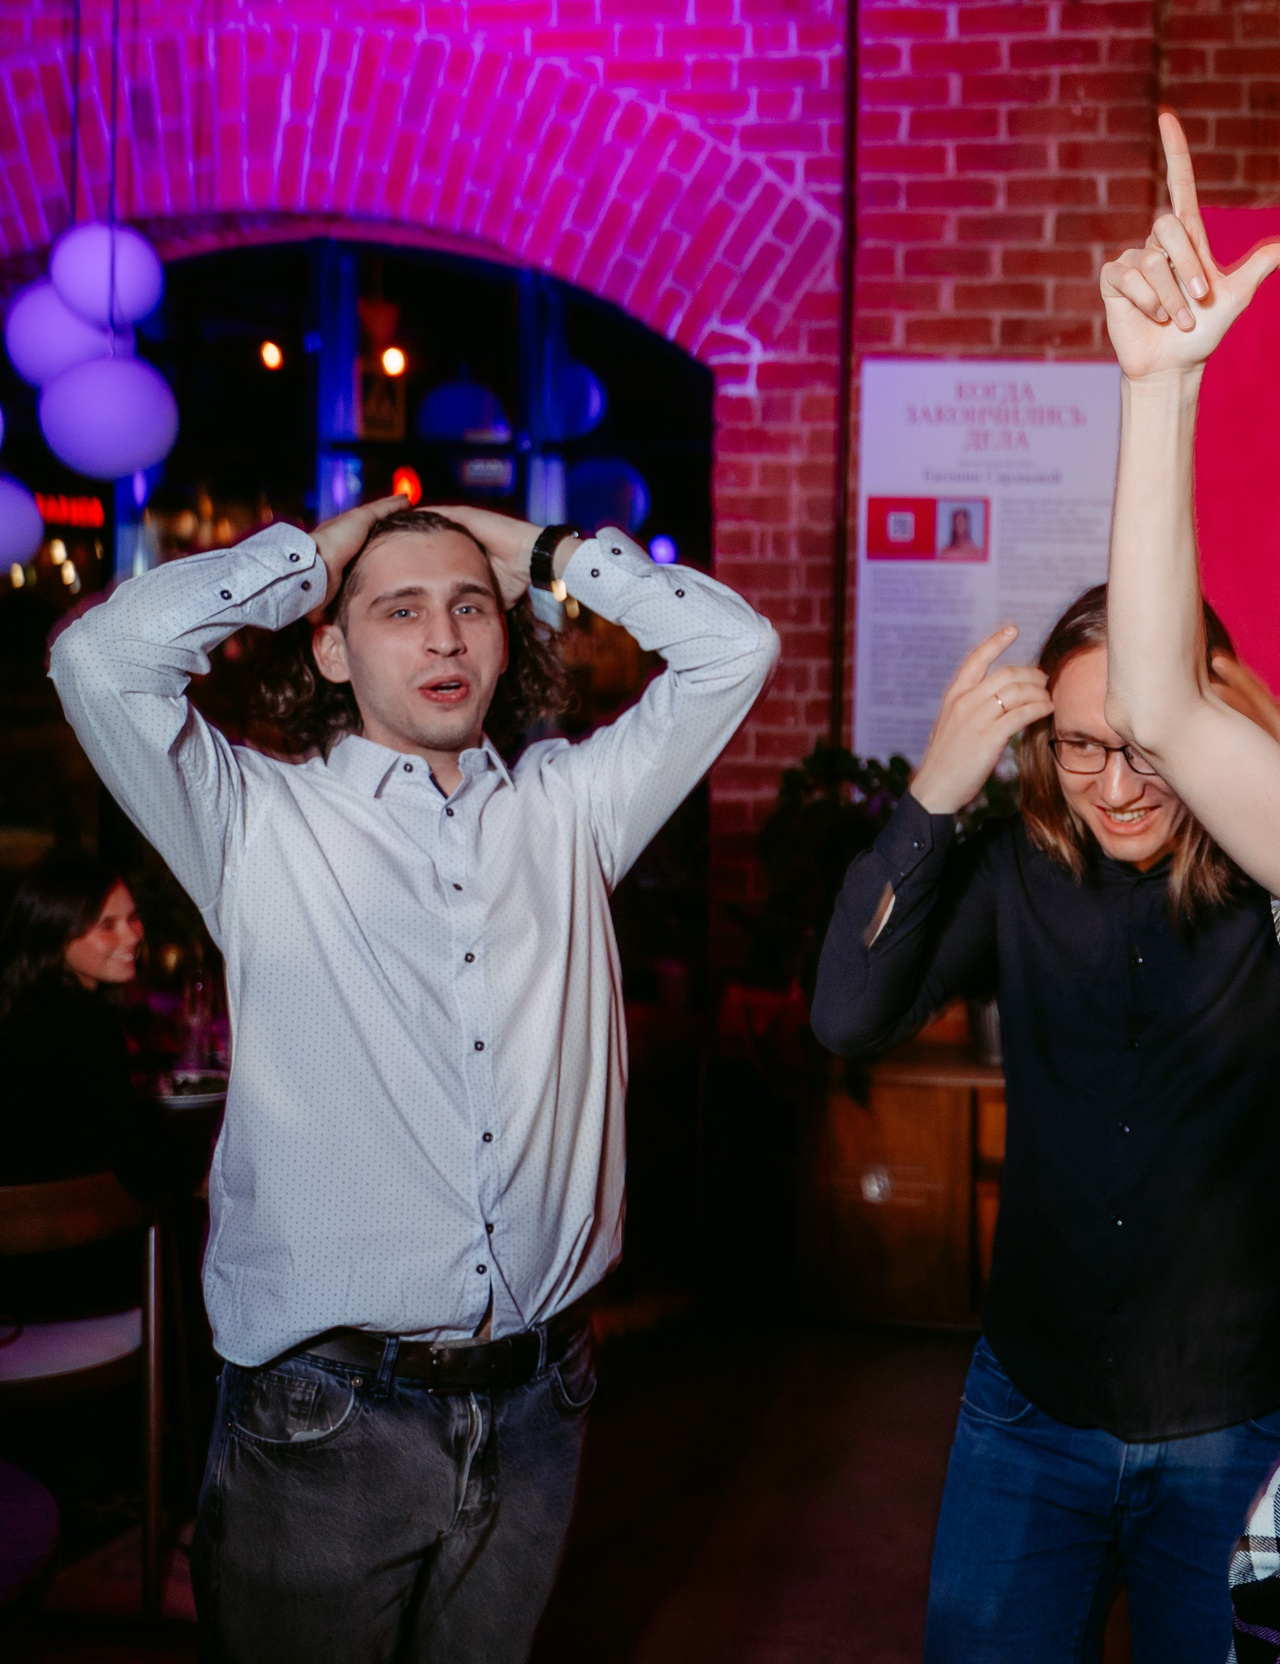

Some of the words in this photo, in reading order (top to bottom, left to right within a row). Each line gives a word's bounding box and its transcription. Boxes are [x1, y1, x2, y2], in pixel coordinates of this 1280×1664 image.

[955, 381, 1035, 403] КОГДА
[906, 404, 1088, 426] ЗАКОНЧИЛИСЬ
[964, 429, 1030, 452] ДЕЛА
